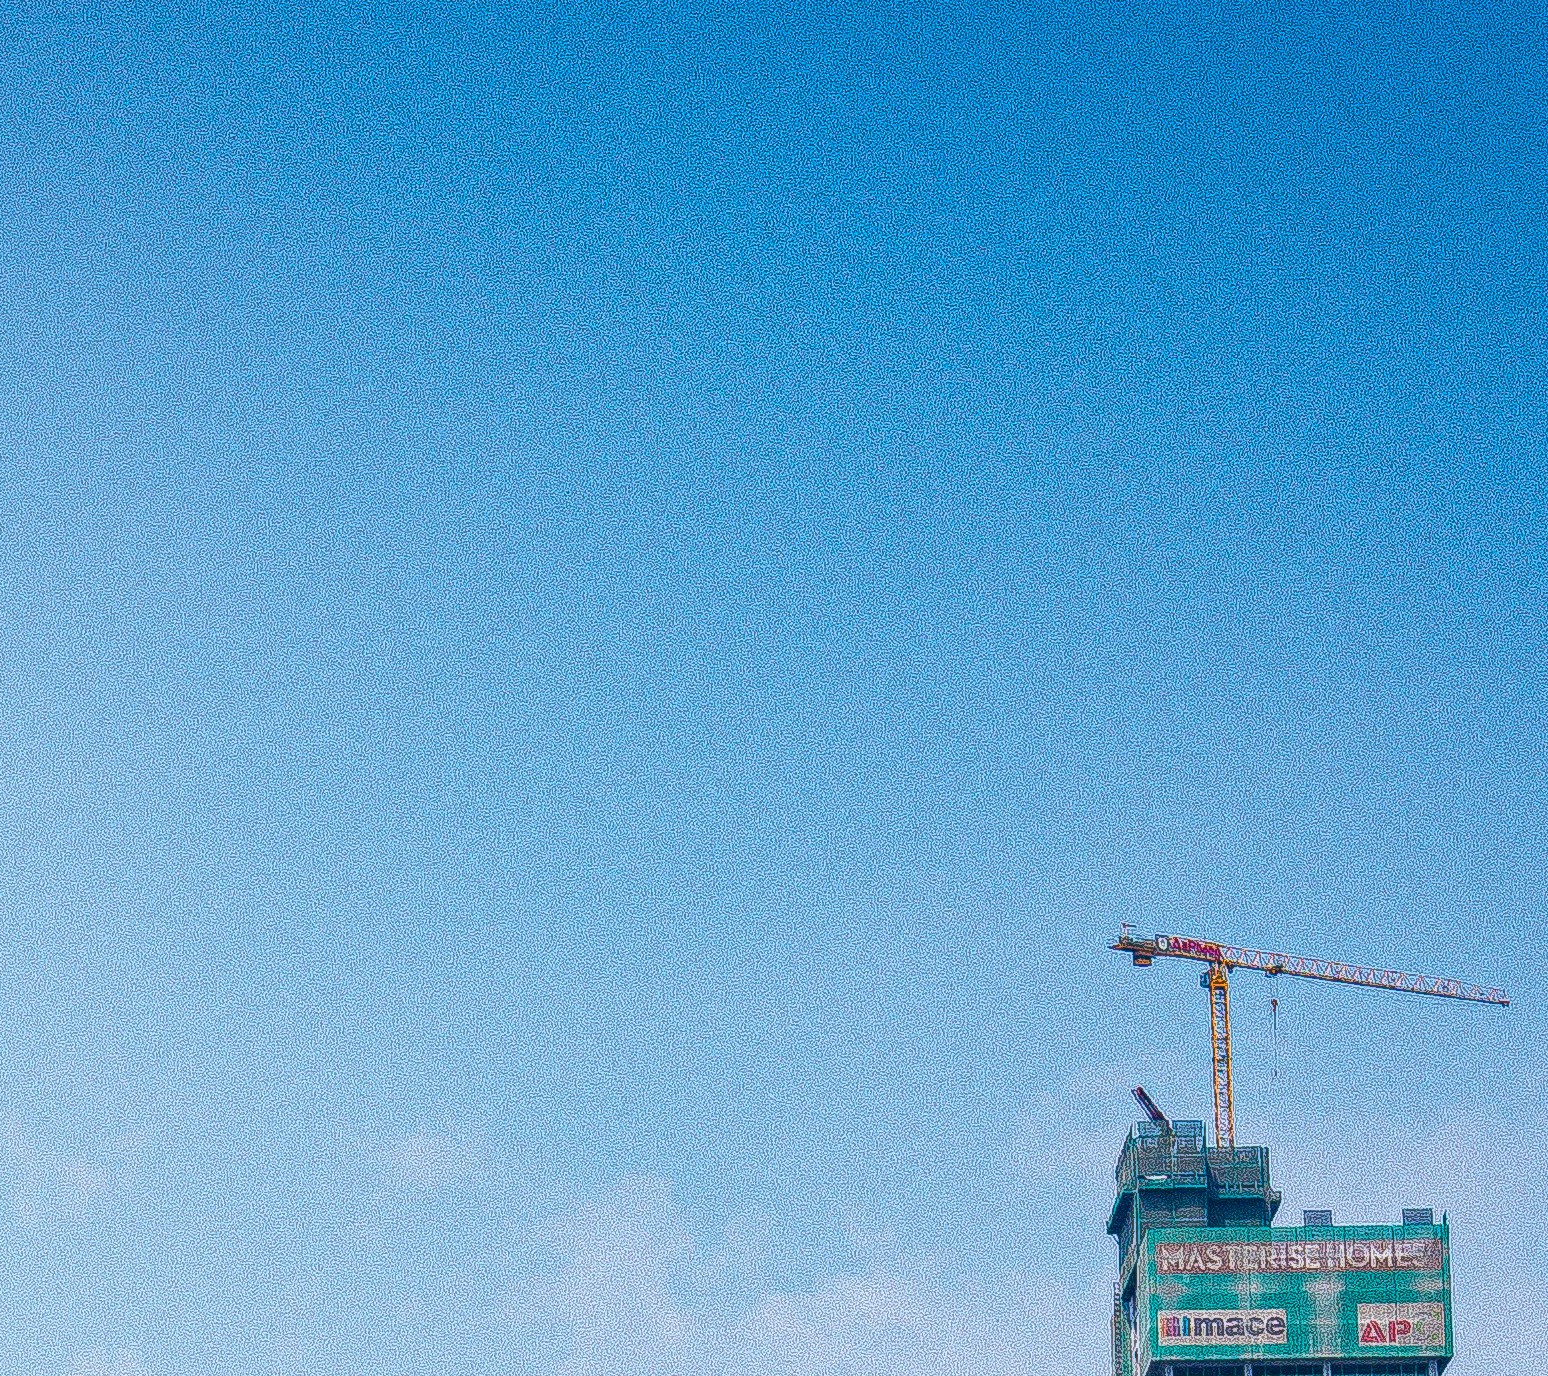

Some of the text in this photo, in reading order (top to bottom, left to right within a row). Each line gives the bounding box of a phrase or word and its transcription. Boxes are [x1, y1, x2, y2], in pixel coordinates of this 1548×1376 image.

[1161, 1243, 1427, 1270] MASTERISE HOMES
[1194, 1316, 1286, 1337] mace
